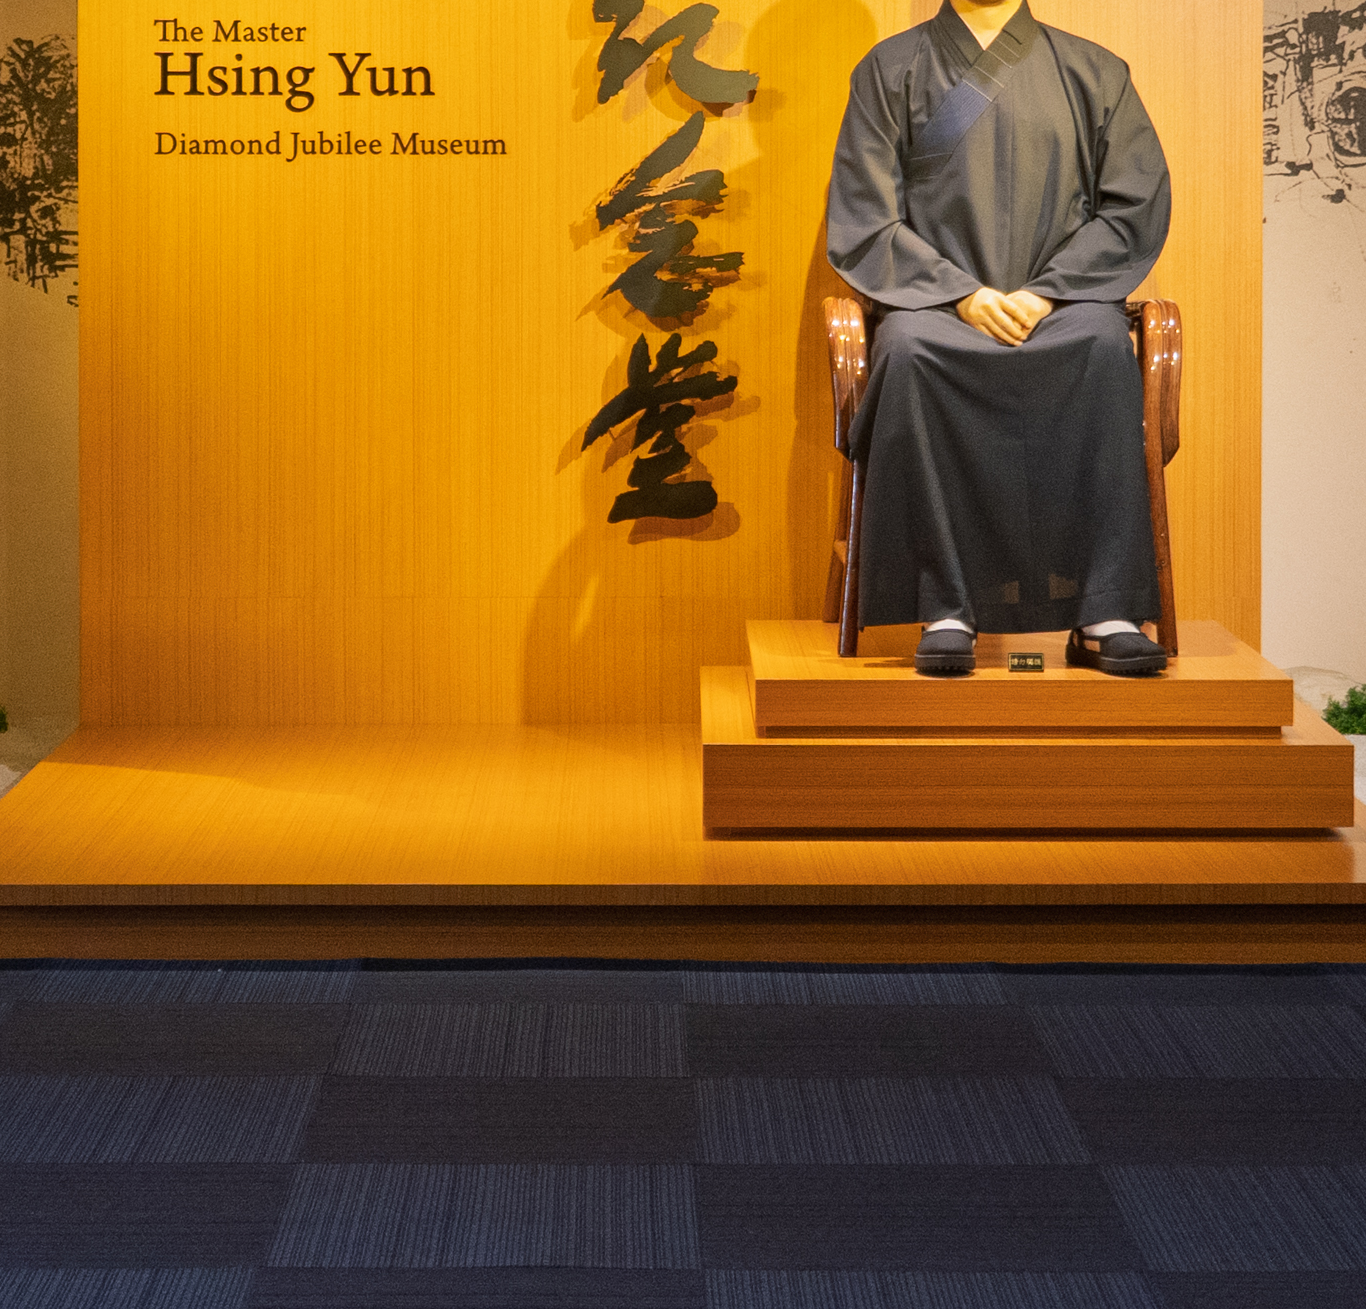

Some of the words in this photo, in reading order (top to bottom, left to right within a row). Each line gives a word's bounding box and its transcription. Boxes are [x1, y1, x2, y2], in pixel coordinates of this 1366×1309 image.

[154, 18, 204, 43] The
[212, 19, 307, 43] Master
[154, 52, 316, 113] Hsing
[328, 52, 436, 97] Yun
[154, 130, 282, 155] Diamond
[285, 131, 382, 163] Jubilee
[391, 132, 507, 156] Museum
